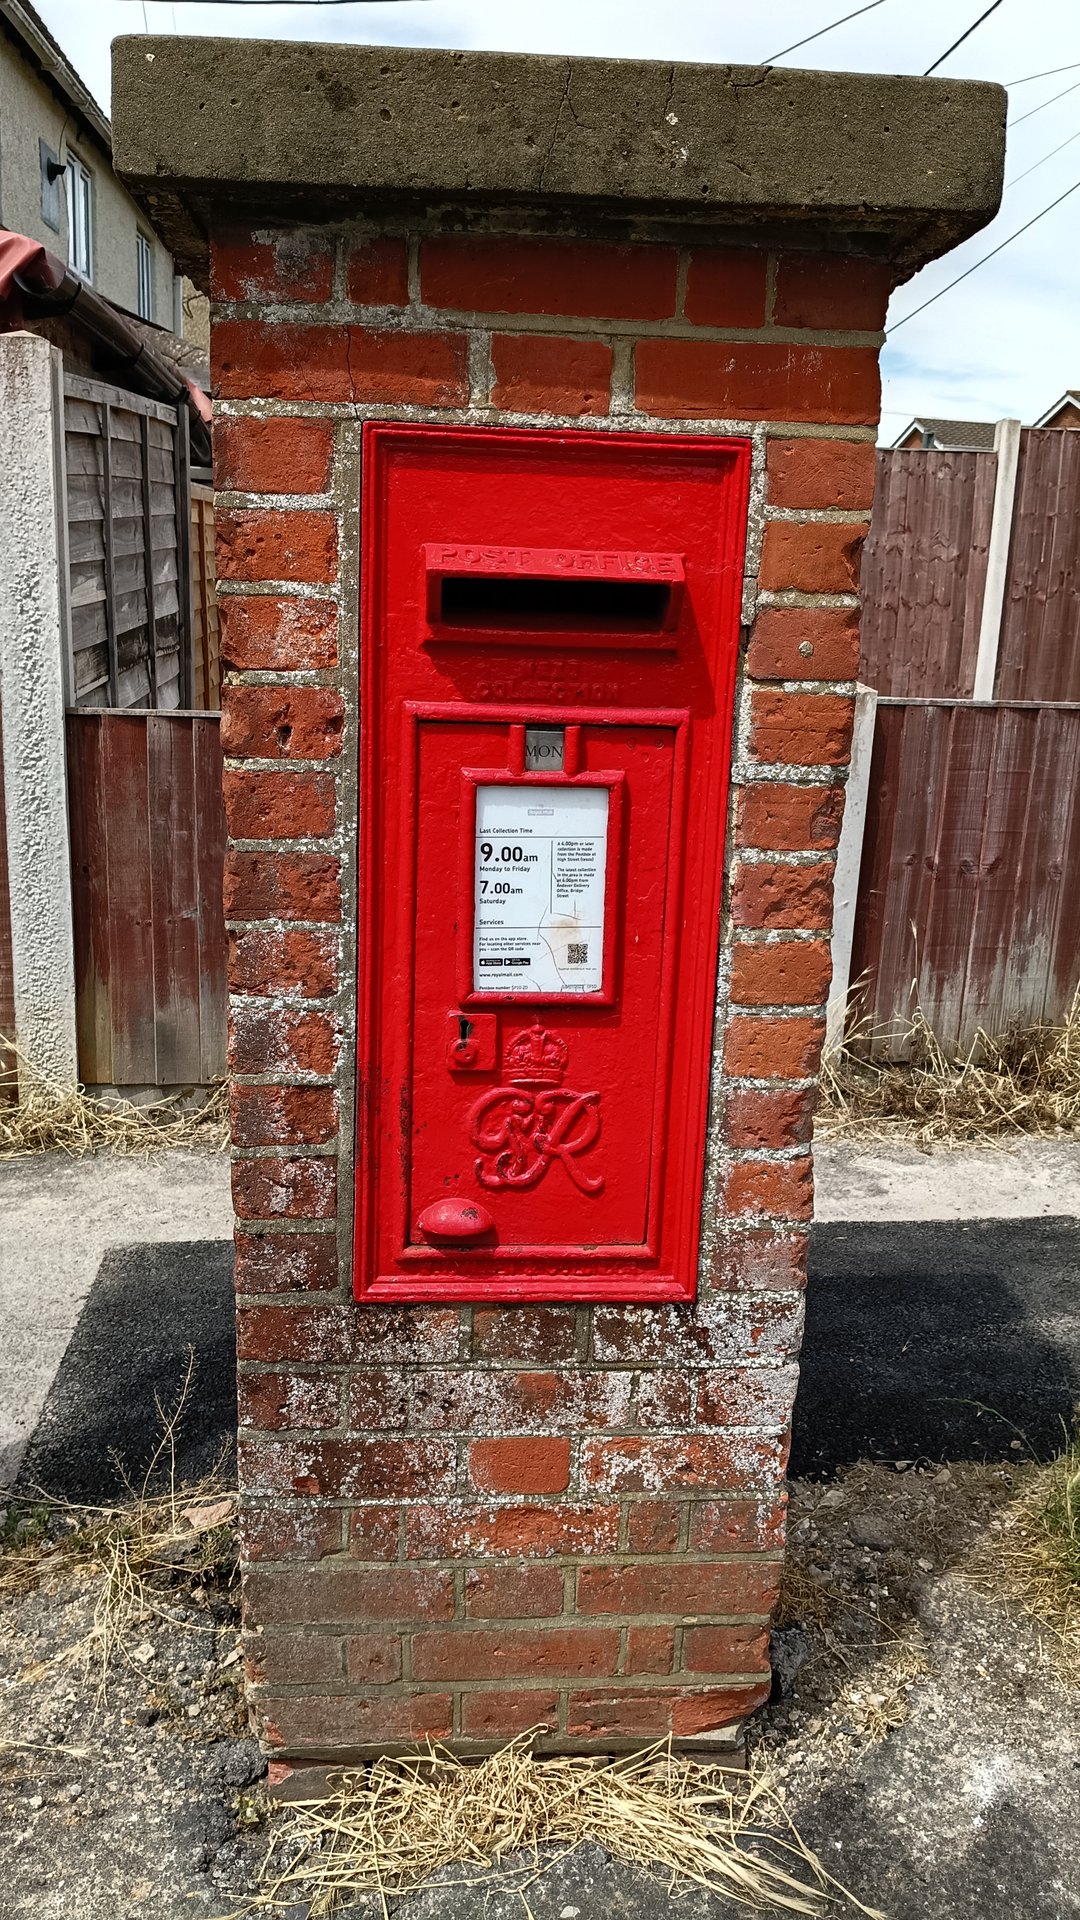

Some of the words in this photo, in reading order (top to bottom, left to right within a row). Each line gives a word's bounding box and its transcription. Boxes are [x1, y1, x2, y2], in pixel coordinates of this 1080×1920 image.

[440, 547, 531, 567] POST
[555, 553, 677, 575] OFFICE
[476, 680, 625, 701] COLLECTION
[525, 744, 563, 758] MON
[480, 842, 539, 862] 9.00am
[479, 880, 523, 895] 7.00am
